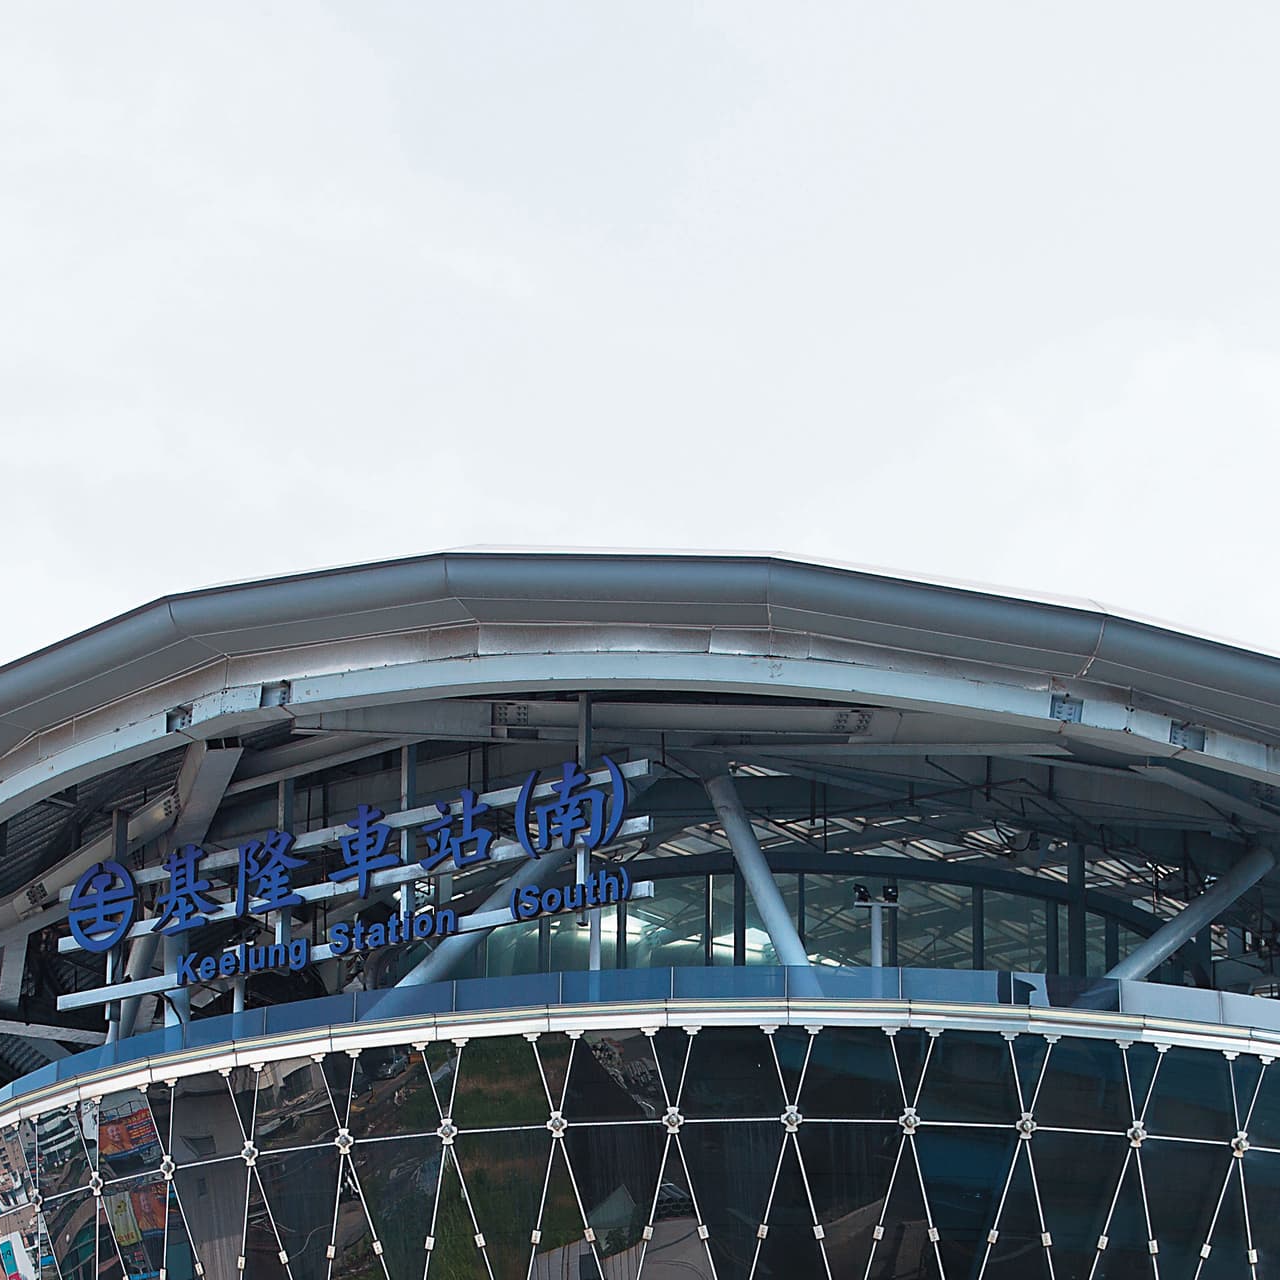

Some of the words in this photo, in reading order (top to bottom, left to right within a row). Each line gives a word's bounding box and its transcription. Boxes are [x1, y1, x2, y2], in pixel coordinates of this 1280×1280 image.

[156, 755, 628, 937] 基隆車站(南)
[176, 937, 309, 986] Keelung
[329, 908, 458, 955] Station
[511, 866, 631, 921] (South)
